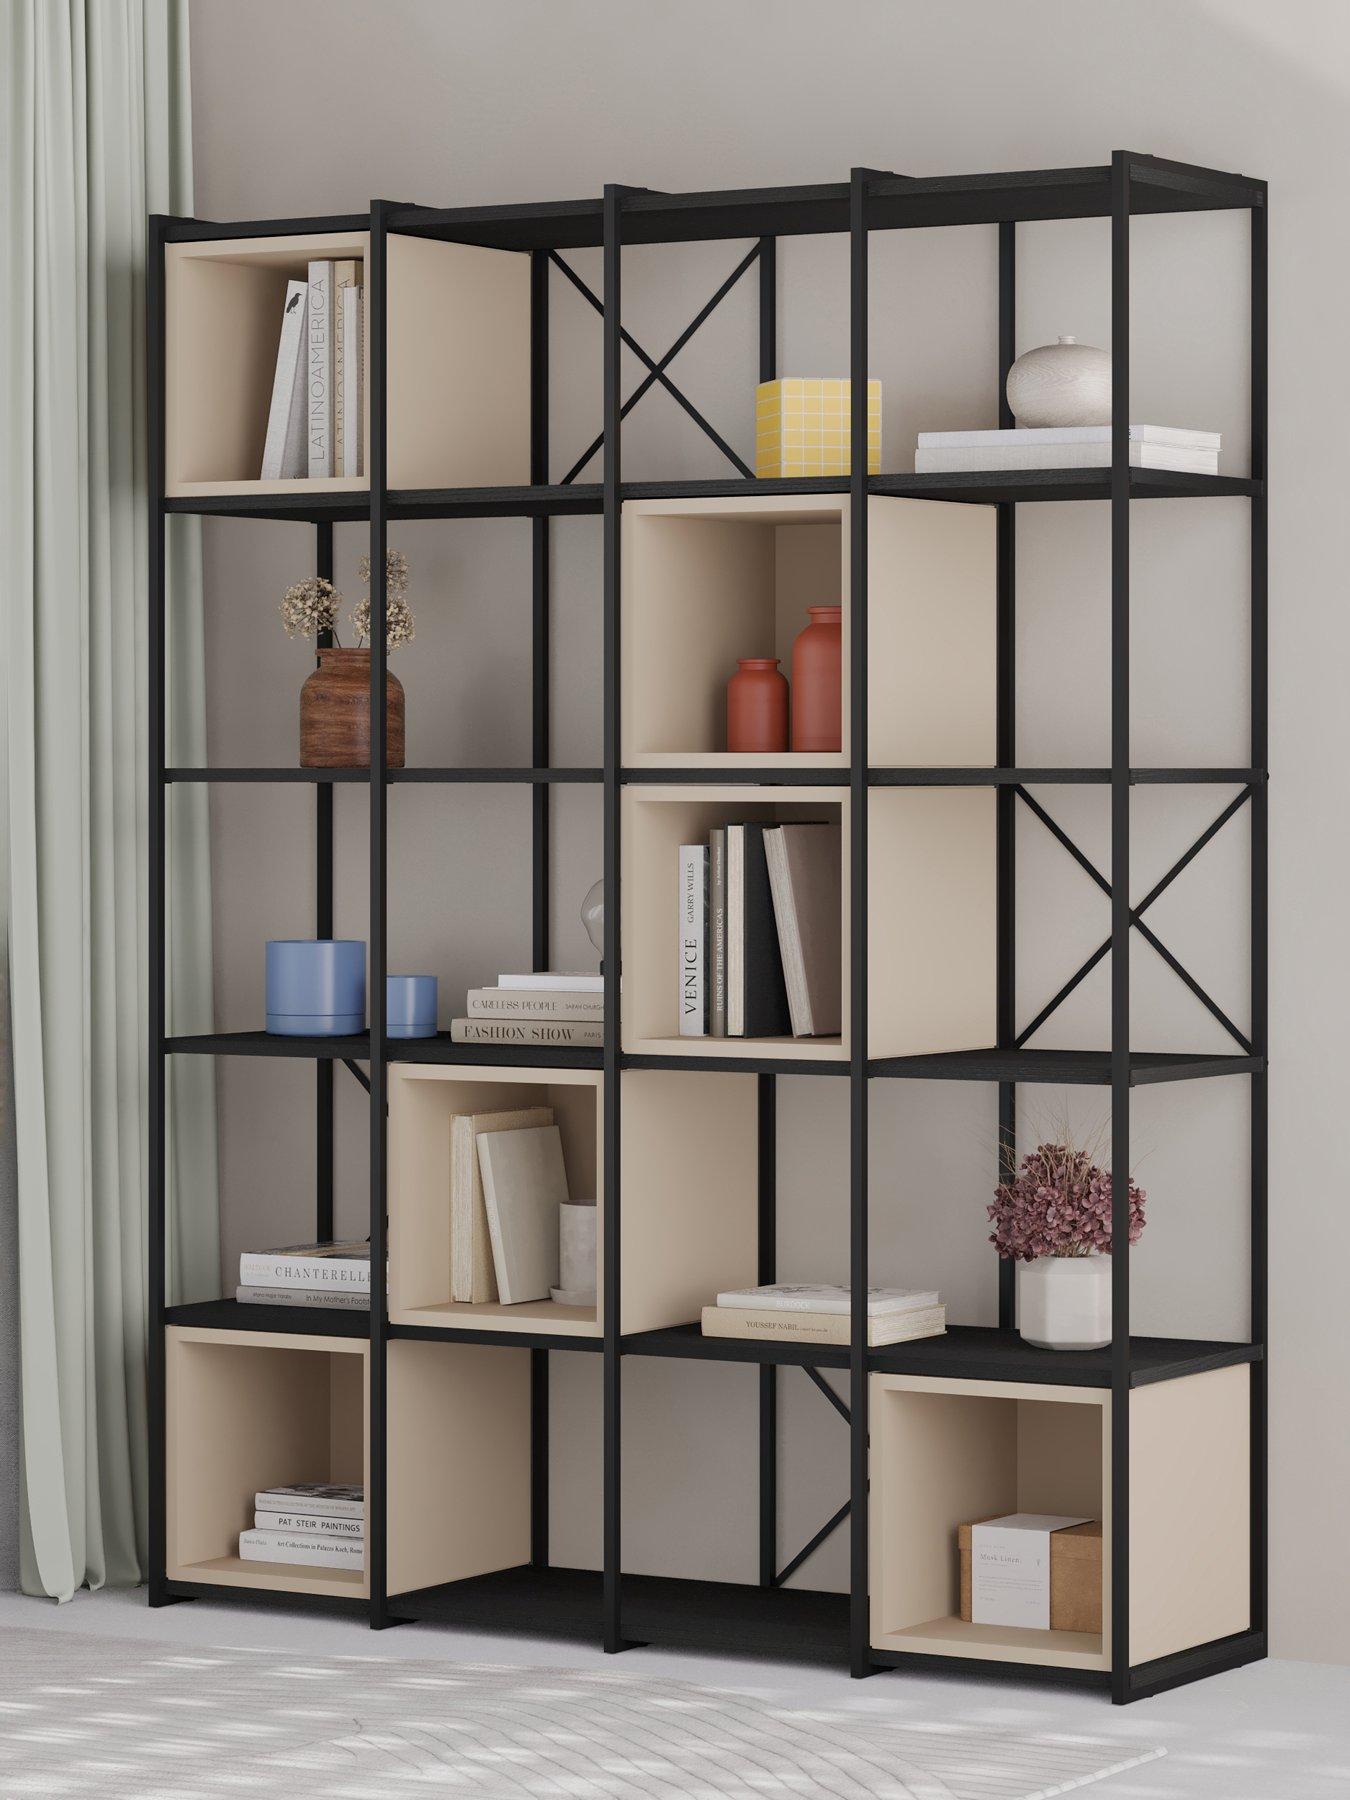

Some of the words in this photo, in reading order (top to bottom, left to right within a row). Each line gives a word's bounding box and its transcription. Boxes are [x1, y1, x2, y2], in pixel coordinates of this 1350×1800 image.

[311, 279, 325, 460] LATINOAMERICA
[687, 862, 695, 891] WILLS
[687, 893, 695, 924] GARRY
[716, 908, 724, 953] AMERICAS
[716, 955, 724, 973] THE
[684, 939, 698, 1015] VENICE
[716, 974, 724, 984] OF
[472, 999, 520, 1010] CARELESS
[522, 1001, 557, 1012] PEOPLE
[716, 985, 724, 1012] RUINS
[464, 1025, 526, 1039] FASHION
[531, 1028, 575, 1040] SHOW
[583, 1031, 602, 1039] PARIS
[313, 1295, 322, 1303] My
[323, 1296, 351, 1305] Mother's
[745, 1320, 777, 1330] YOUSSEF
[778, 1322, 800, 1331] NABIL
[278, 1517, 292, 1527] PAT
[296, 1519, 317, 1529] STEIR
[321, 1521, 361, 1533] PAINTINGS
[285, 1541, 310, 1550] Collections
